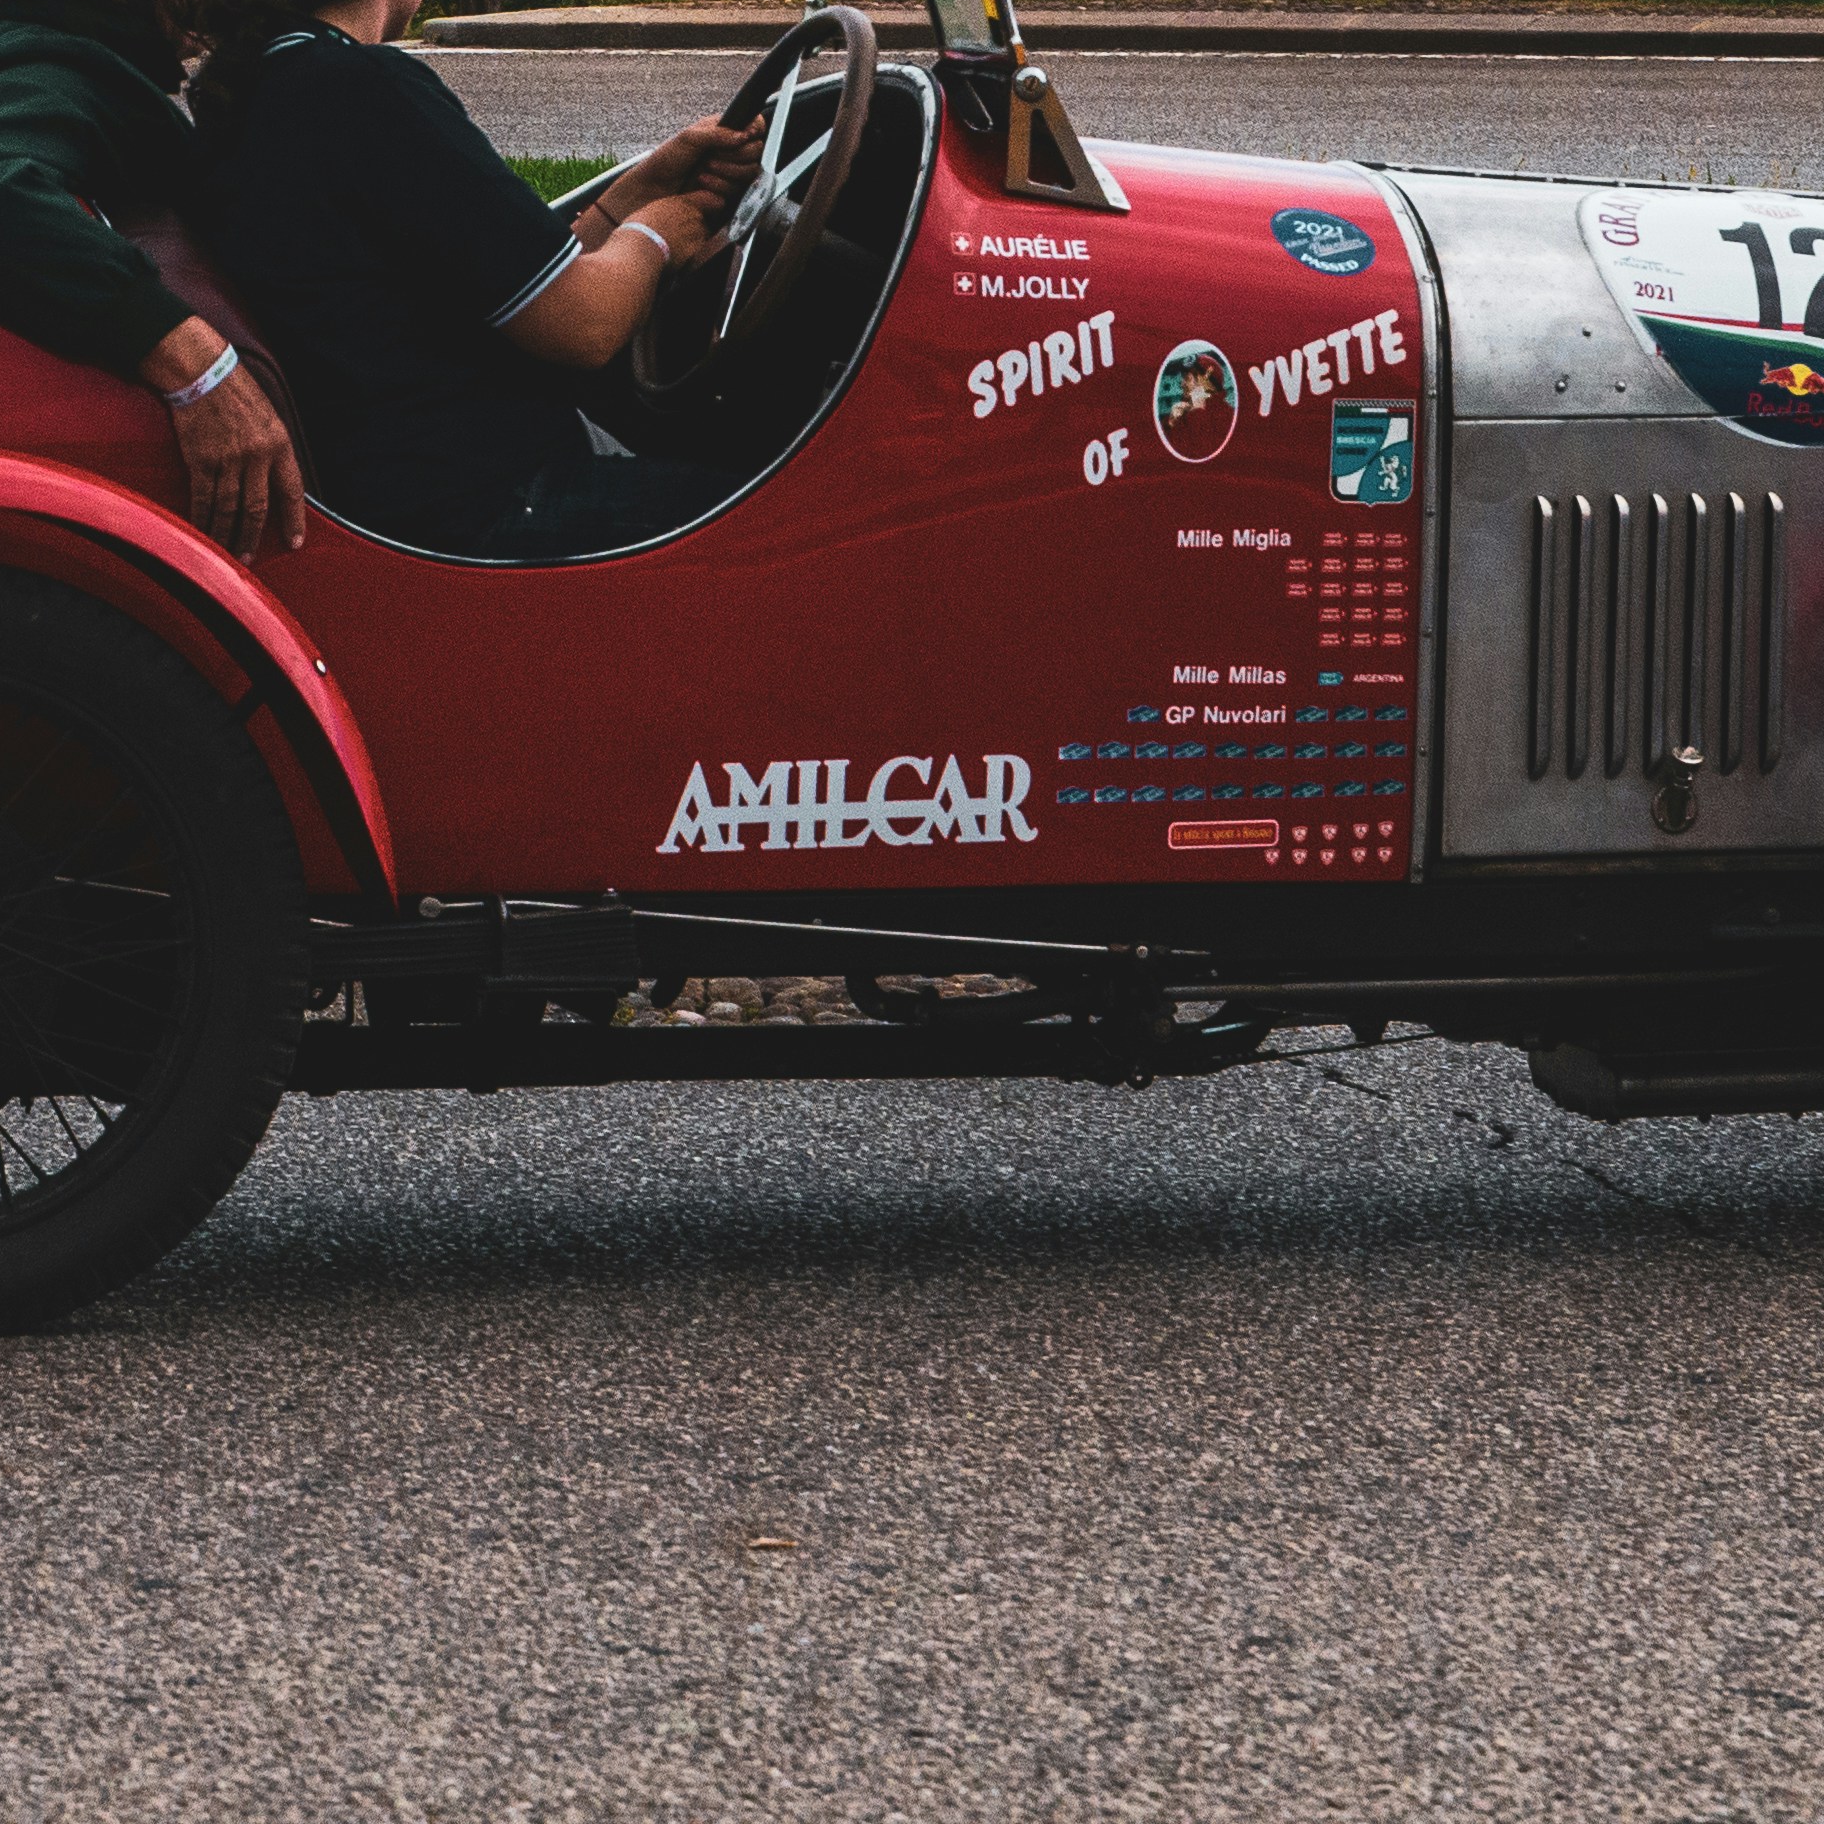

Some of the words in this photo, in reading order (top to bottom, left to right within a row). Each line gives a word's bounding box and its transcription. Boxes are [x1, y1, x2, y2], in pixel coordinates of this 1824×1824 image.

[1294, 220, 1343, 239] 2021
[980, 232, 1090, 260] AURÉLIE
[981, 275, 1090, 300] M.JOLLY
[1633, 281, 1674, 302] 2021
[968, 310, 1116, 418] SPIRIT
[1083, 428, 1131, 486] OF
[1248, 309, 1408, 417] YVETTE
[1177, 528, 1224, 548] Mille
[1232, 528, 1292, 551] Miglia
[1173, 665, 1220, 684] Mille
[1228, 665, 1287, 684] Millas
[1165, 705, 1195, 725] GP
[1203, 704, 1287, 724] Nuvolari
[655, 753, 1038, 854] AMILCAR
